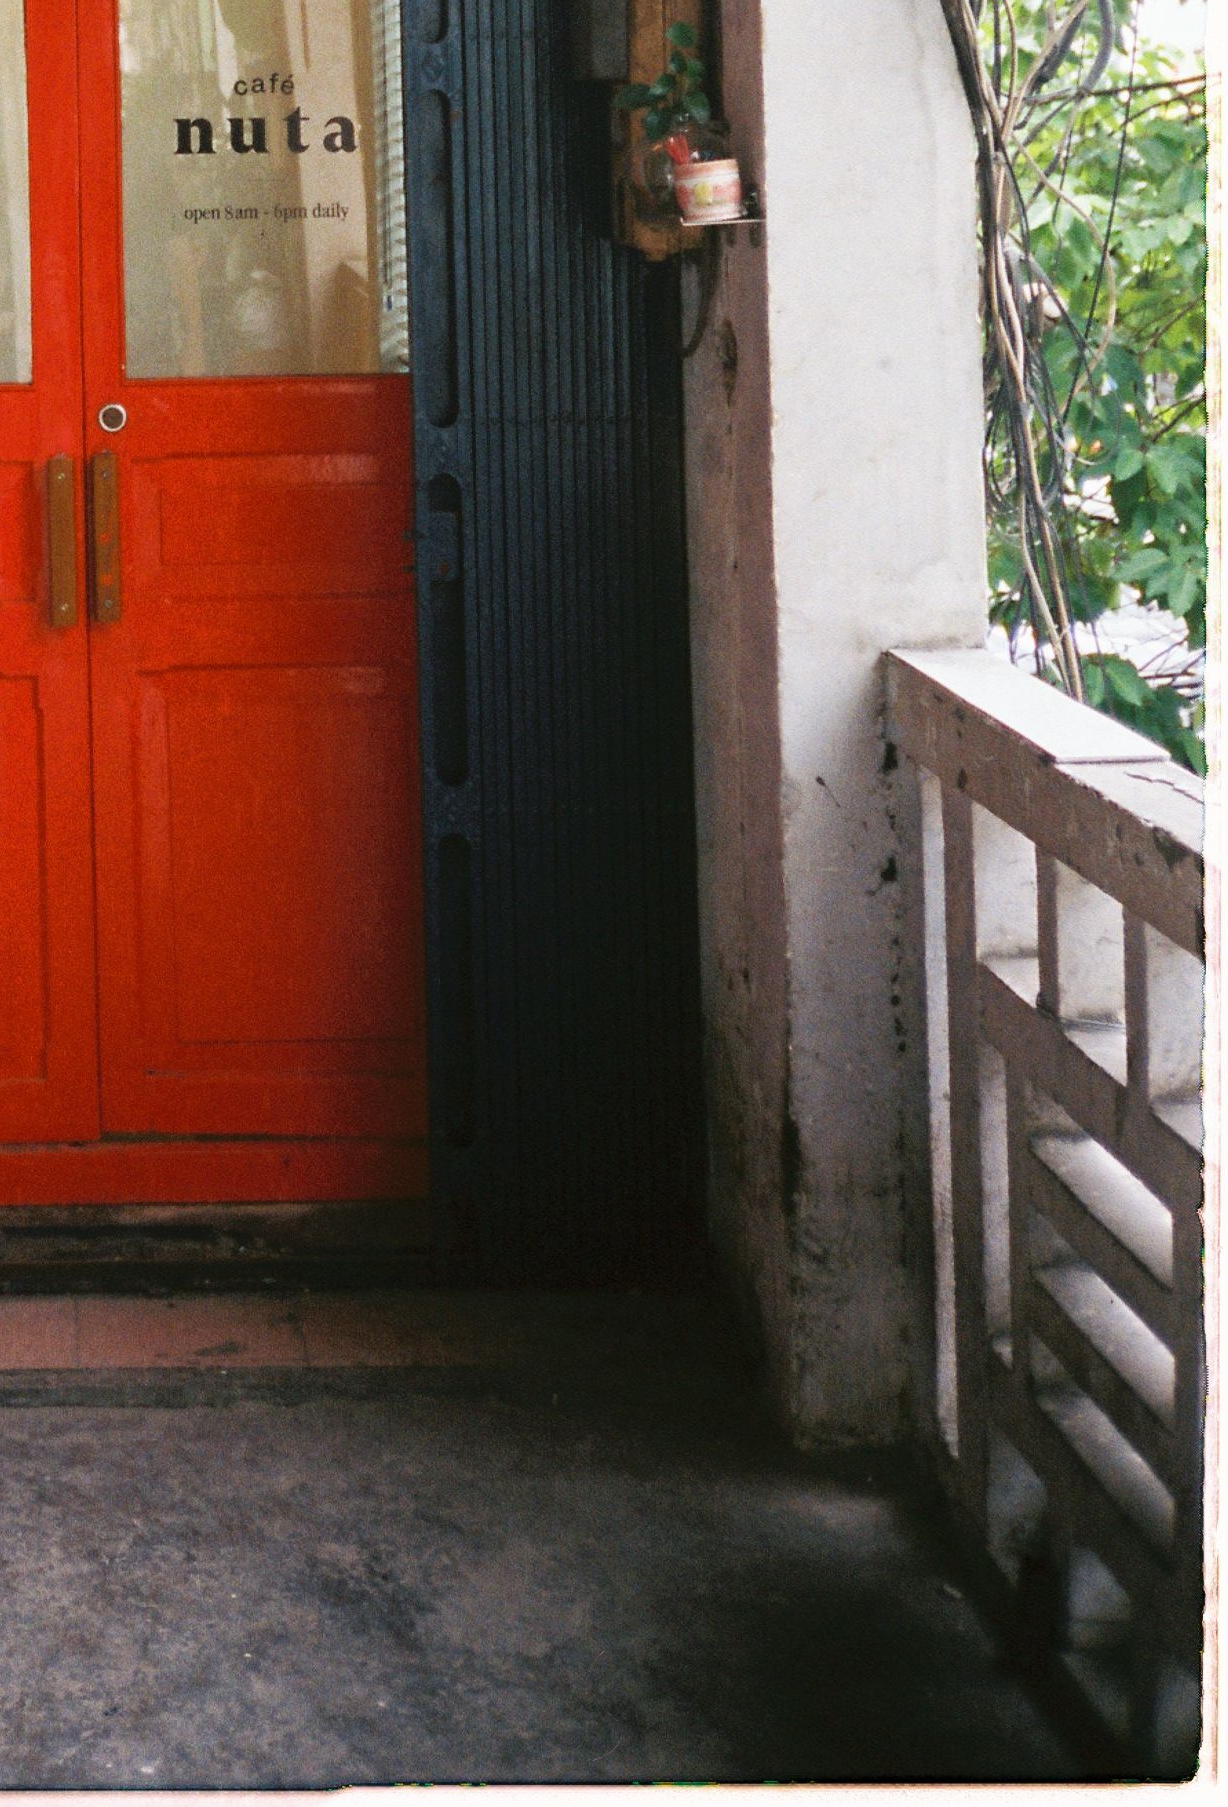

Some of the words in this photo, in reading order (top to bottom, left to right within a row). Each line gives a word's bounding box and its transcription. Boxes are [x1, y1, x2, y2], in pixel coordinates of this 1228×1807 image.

[233, 73, 295, 95] café
[173, 106, 358, 155] nuta
[184, 206, 221, 224] open
[224, 204, 259, 220] 8am
[273, 202, 308, 223] 6pm
[312, 201, 350, 222] daily
